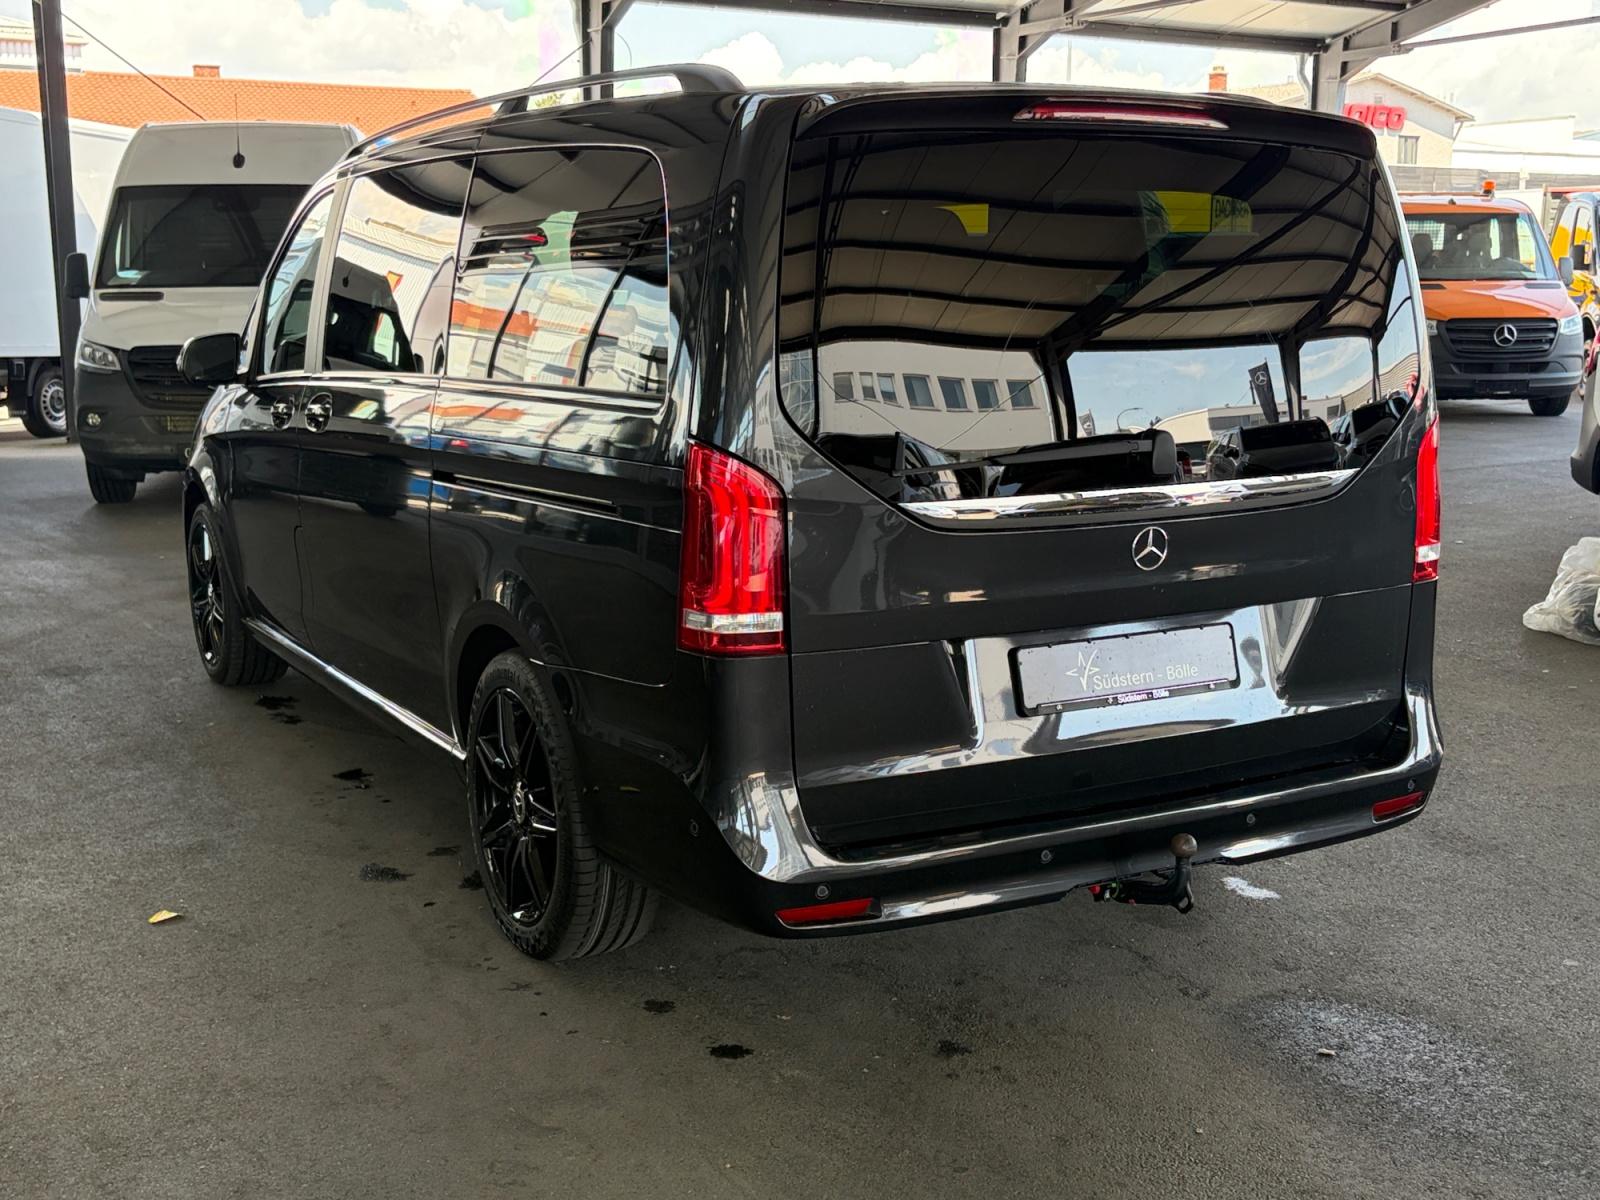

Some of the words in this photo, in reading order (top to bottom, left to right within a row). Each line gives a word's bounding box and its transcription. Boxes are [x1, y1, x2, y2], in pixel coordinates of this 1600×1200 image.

[1093, 672, 1154, 690] Südstern
[1166, 663, 1199, 680] Bölle
[1117, 693, 1148, 703] Südstern
